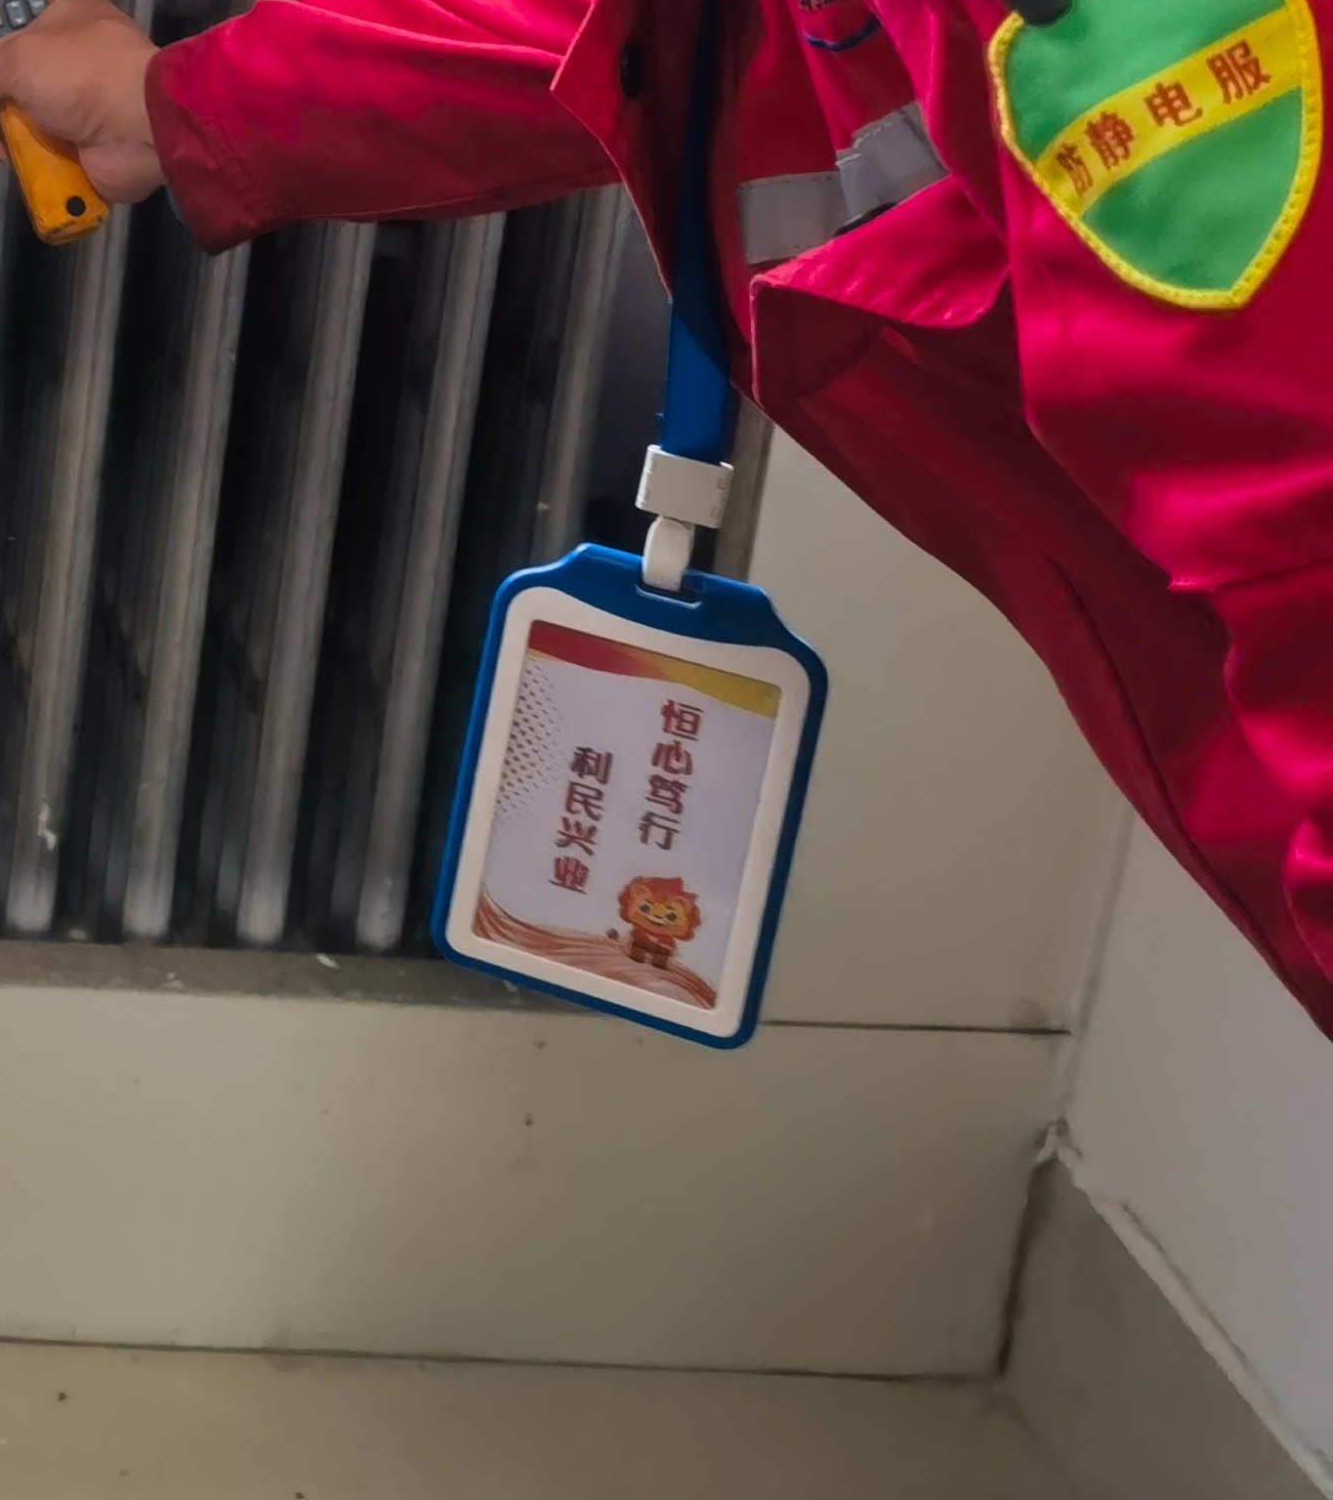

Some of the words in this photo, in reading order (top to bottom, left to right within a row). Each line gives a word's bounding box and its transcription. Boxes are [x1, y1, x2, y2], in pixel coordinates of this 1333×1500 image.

[1056, 39, 1271, 198] 防静电服
[548, 745, 614, 896] 利民兴业
[638, 698, 704, 852] 恒心笃行
